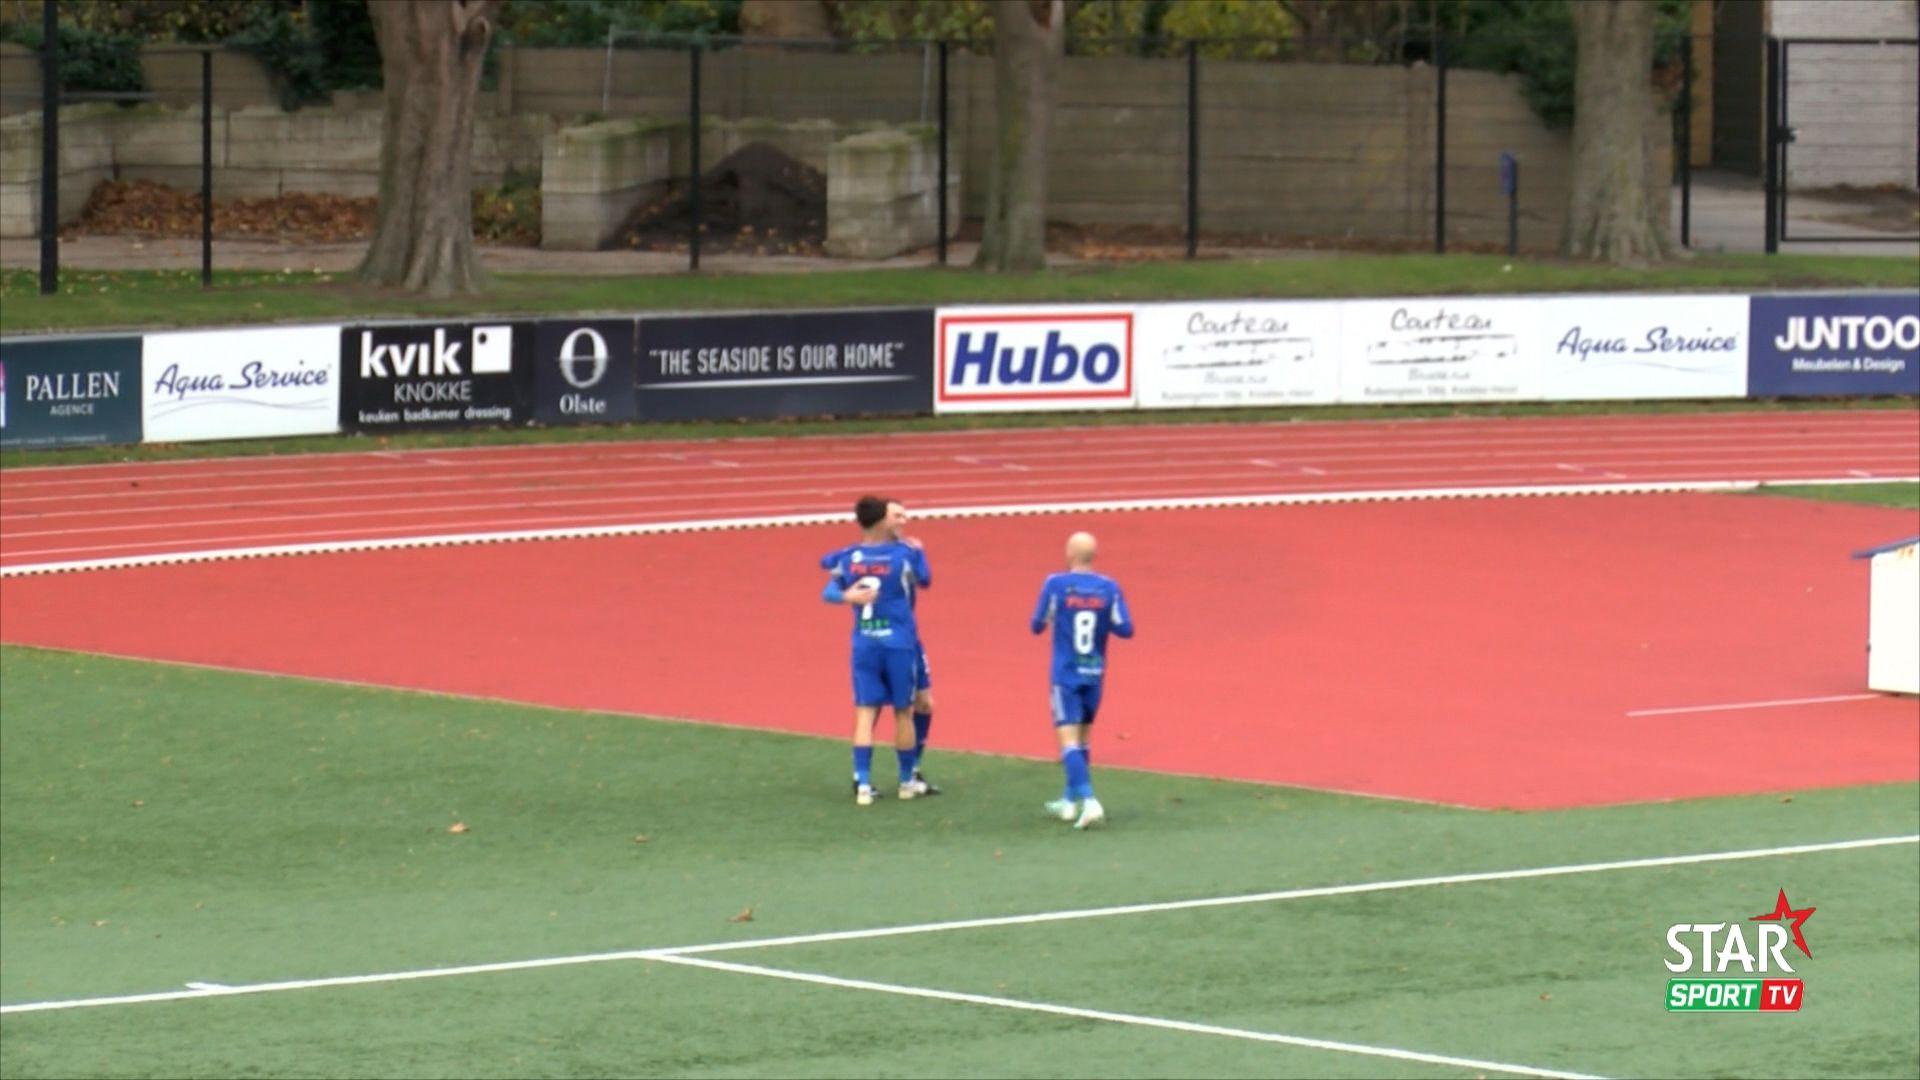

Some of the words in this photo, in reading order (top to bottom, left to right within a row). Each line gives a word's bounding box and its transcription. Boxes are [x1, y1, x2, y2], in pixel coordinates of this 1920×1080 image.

[1557, 326, 1627, 361] Aqua
[1634, 327, 1737, 353] Service
[1775, 315, 1919, 350] JUNTOO
[360, 328, 462, 378] kvik
[697, 346, 770, 374] SEASIDE
[777, 346, 794, 370] IS
[800, 345, 837, 369] OUR
[950, 330, 1120, 385] Hubo
[1863, 357, 1905, 373] Design
[26, 371, 120, 400] PALLEN
[154, 363, 223, 400] Aqua
[229, 360, 328, 390] Service
[394, 380, 472, 402] KNOKKE
[50, 403, 94, 416] AGENCE
[358, 409, 399, 423] keuken
[404, 407, 459, 422] badkamer
[464, 406, 511, 421] dressing
[1074, 610, 1096, 655] 8
